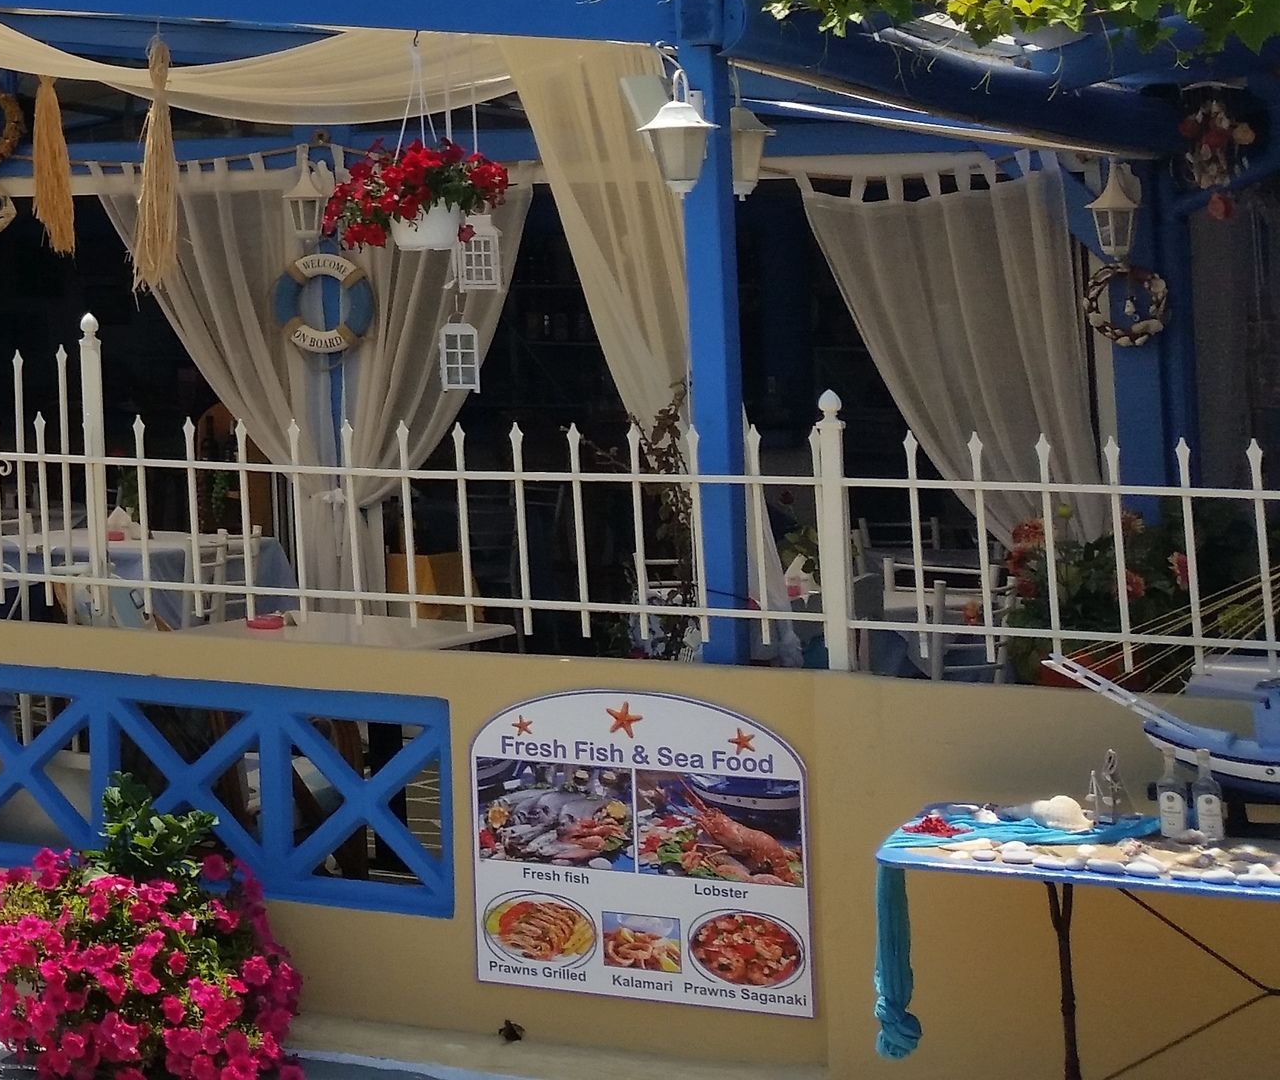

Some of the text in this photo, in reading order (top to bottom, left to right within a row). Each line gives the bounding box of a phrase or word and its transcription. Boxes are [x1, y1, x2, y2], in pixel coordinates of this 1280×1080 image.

[302, 259, 348, 275] WELCOME
[293, 329, 343, 349] ON BOARD
[501, 735, 774, 774] Fresh Fish & Sea Food
[523, 867, 590, 885] Fresh fish
[694, 883, 749, 900] Lobster
[489, 960, 587, 982] Prawns Grilled
[612, 974, 673, 992] Kalamari
[684, 982, 807, 1007] Prawns Saganaki
